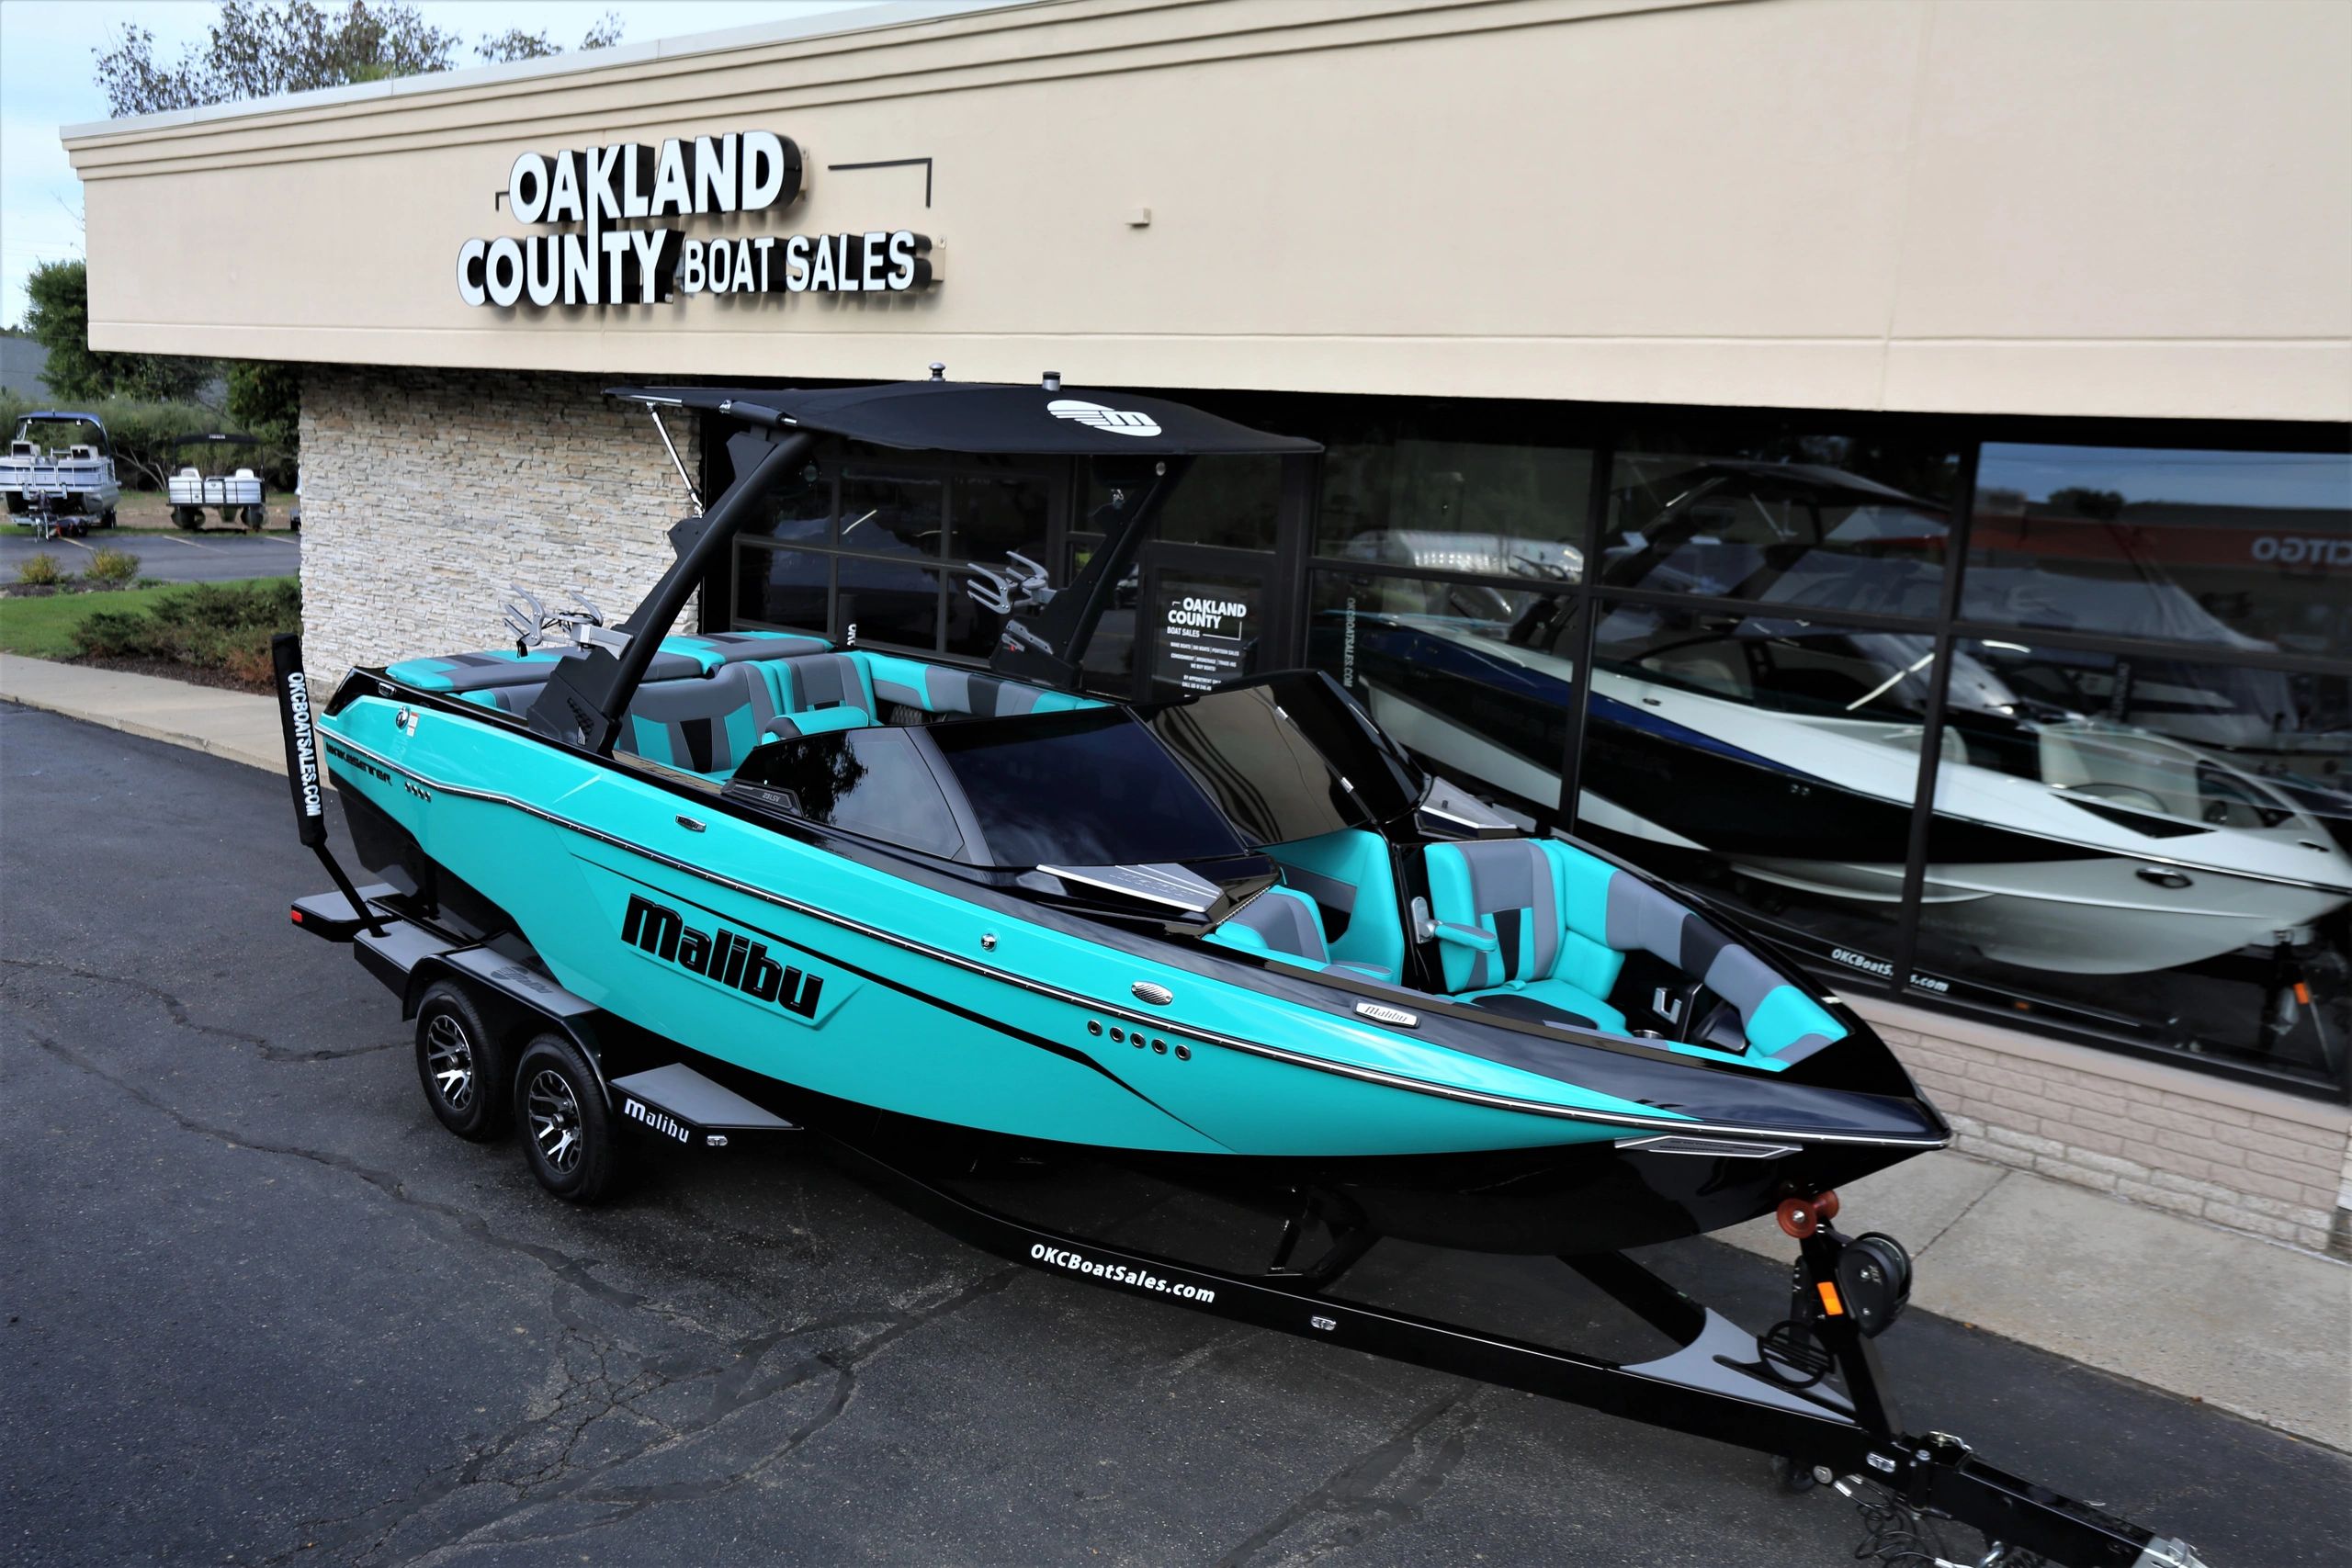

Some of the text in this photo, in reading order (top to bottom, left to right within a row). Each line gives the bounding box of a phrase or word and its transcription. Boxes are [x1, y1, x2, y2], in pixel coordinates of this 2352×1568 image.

[509, 130, 786, 224] OAKLAND
[457, 228, 916, 308] COUNTY BOAT SALES
[1167, 626, 1200, 637] BOAT SALES
[1168, 609, 1222, 629] COUNTY
[1182, 597, 1247, 617] OAKLAND
[287, 671, 322, 817] OKCBOATSALES.COM
[1030, 1243, 1216, 1303] OKCBoatSales.com
